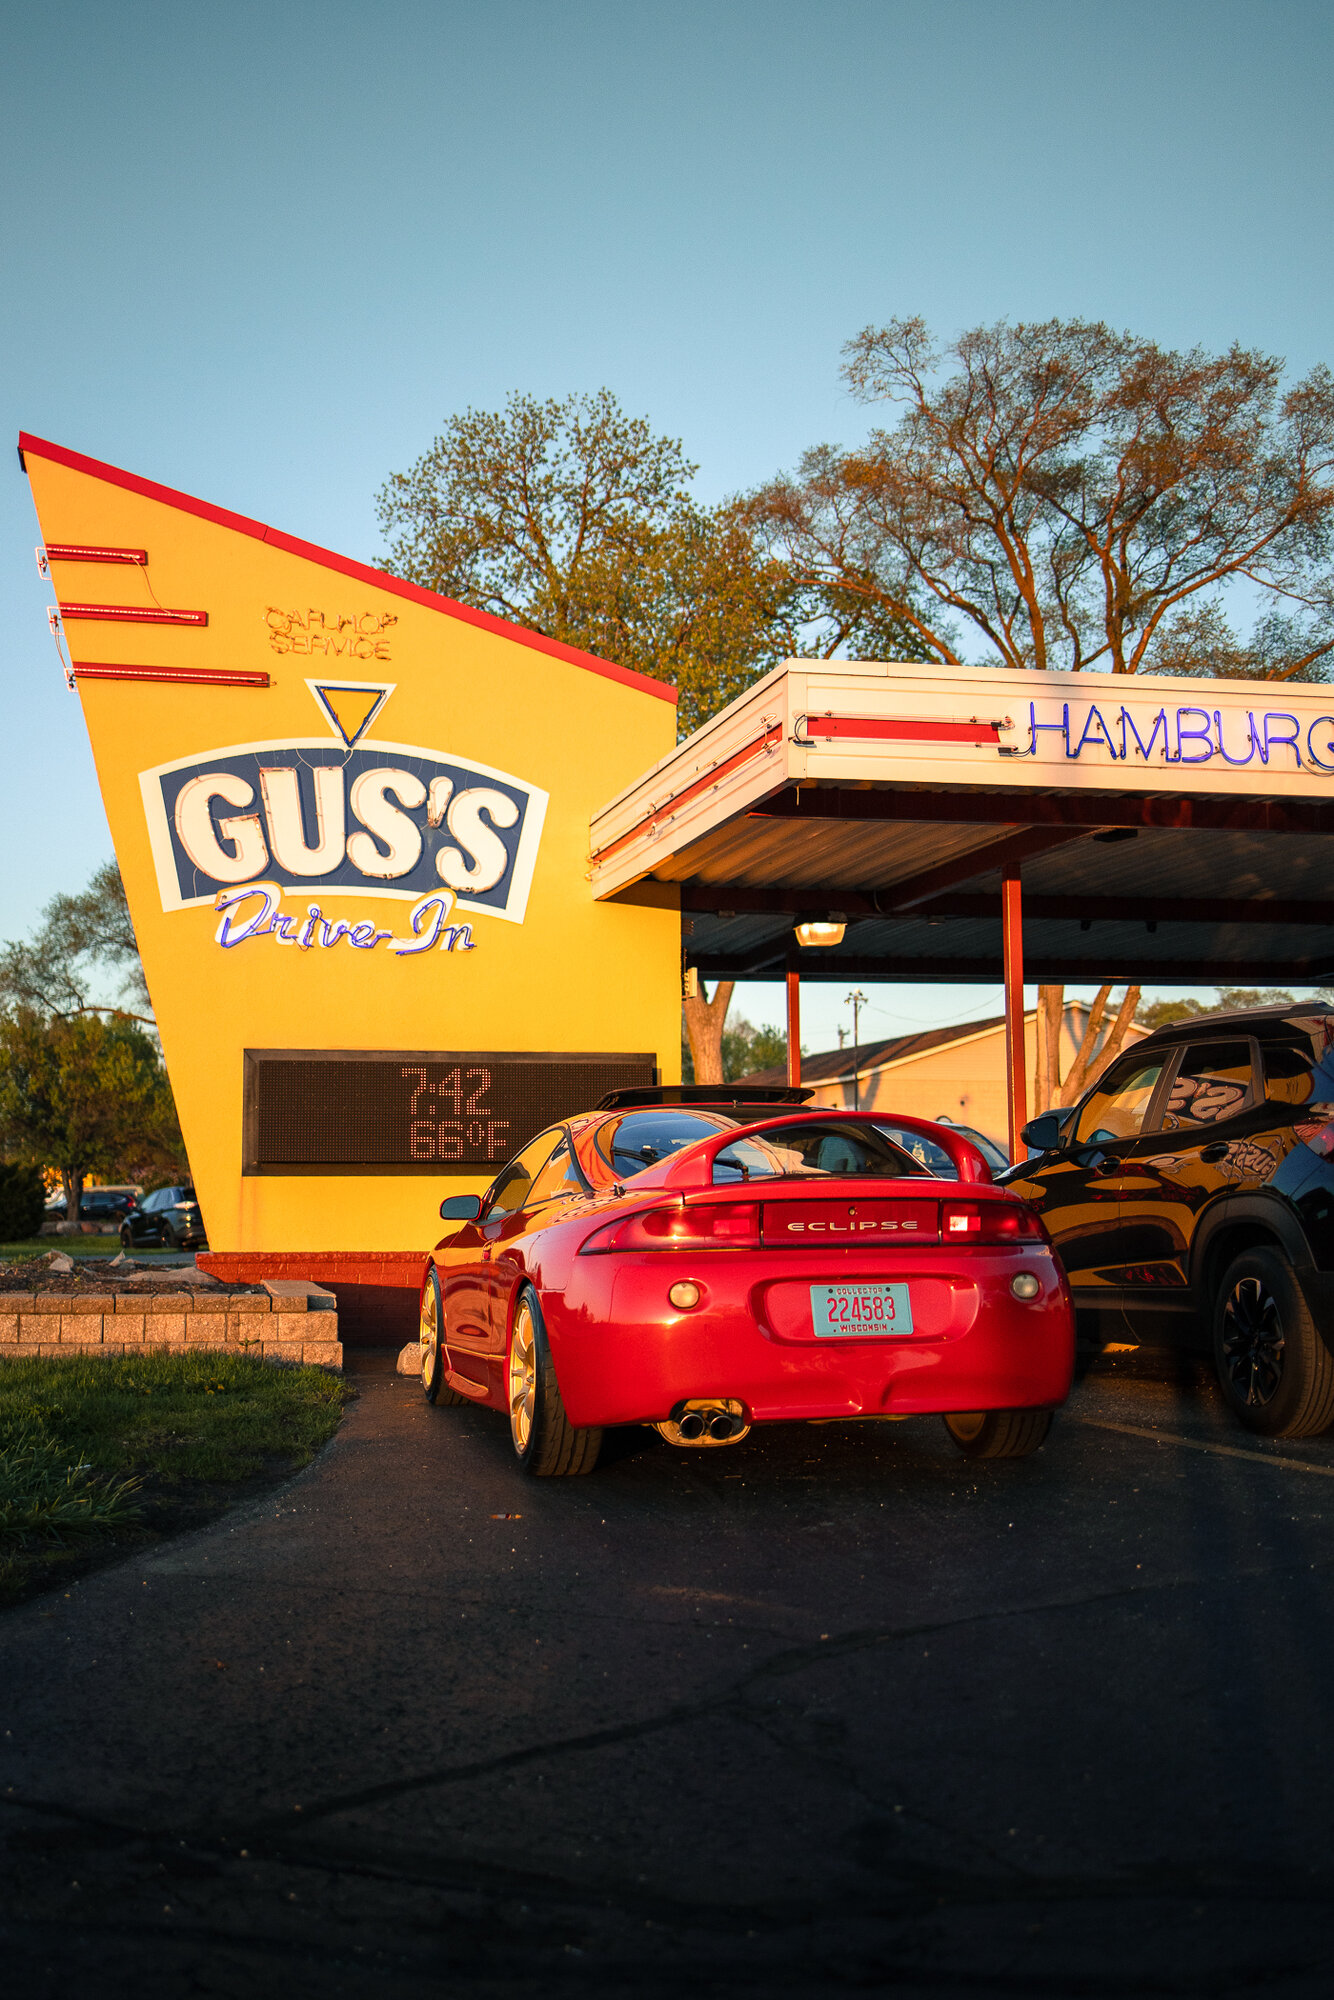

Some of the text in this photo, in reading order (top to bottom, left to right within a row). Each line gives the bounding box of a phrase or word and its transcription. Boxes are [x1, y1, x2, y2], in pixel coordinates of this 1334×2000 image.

[269, 630, 392, 659] SERVICE
[174, 766, 520, 894] GUS'S
[401, 1068, 491, 1115] 7:42
[410, 1121, 510, 1158] 66°F
[787, 1220, 918, 1231] ECLIPSE
[836, 1287, 883, 1296] COLLECTOR
[826, 1296, 896, 1323] 224583
[839, 1323, 888, 1332] WISCONSIN
